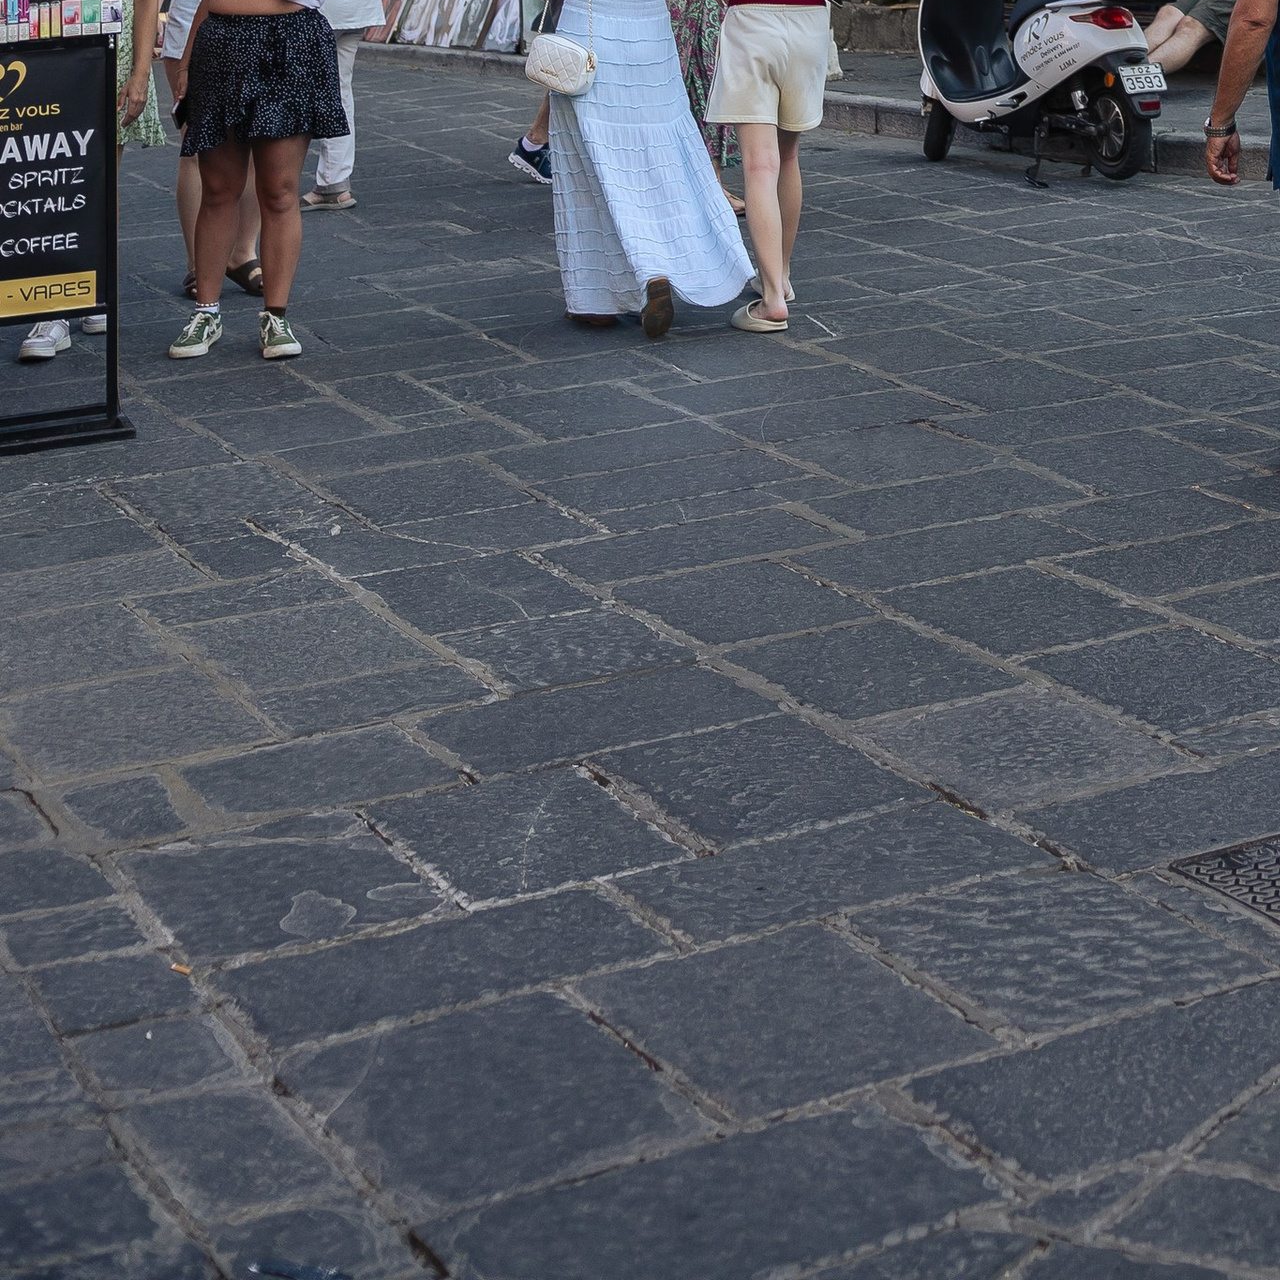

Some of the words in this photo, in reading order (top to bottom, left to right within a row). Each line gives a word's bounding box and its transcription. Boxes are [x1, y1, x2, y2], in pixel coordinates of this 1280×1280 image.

[1020, 41, 1043, 63] rendez
[1044, 31, 1065, 47] vous
[1040, 42, 1063, 59] Delivery
[1059, 58, 1077, 72] LIMA
[1126, 75, 1164, 90] 3593
[15, 103, 61, 118] vous
[10, 122, 24, 131] bar
[0, 128, 95, 165] AWAY
[8, 166, 85, 190] SPRITZ
[0, 194, 87, 219] CKTAILS
[0, 232, 80, 258] COFFEE
[20, 280, 91, 301] VAPES
